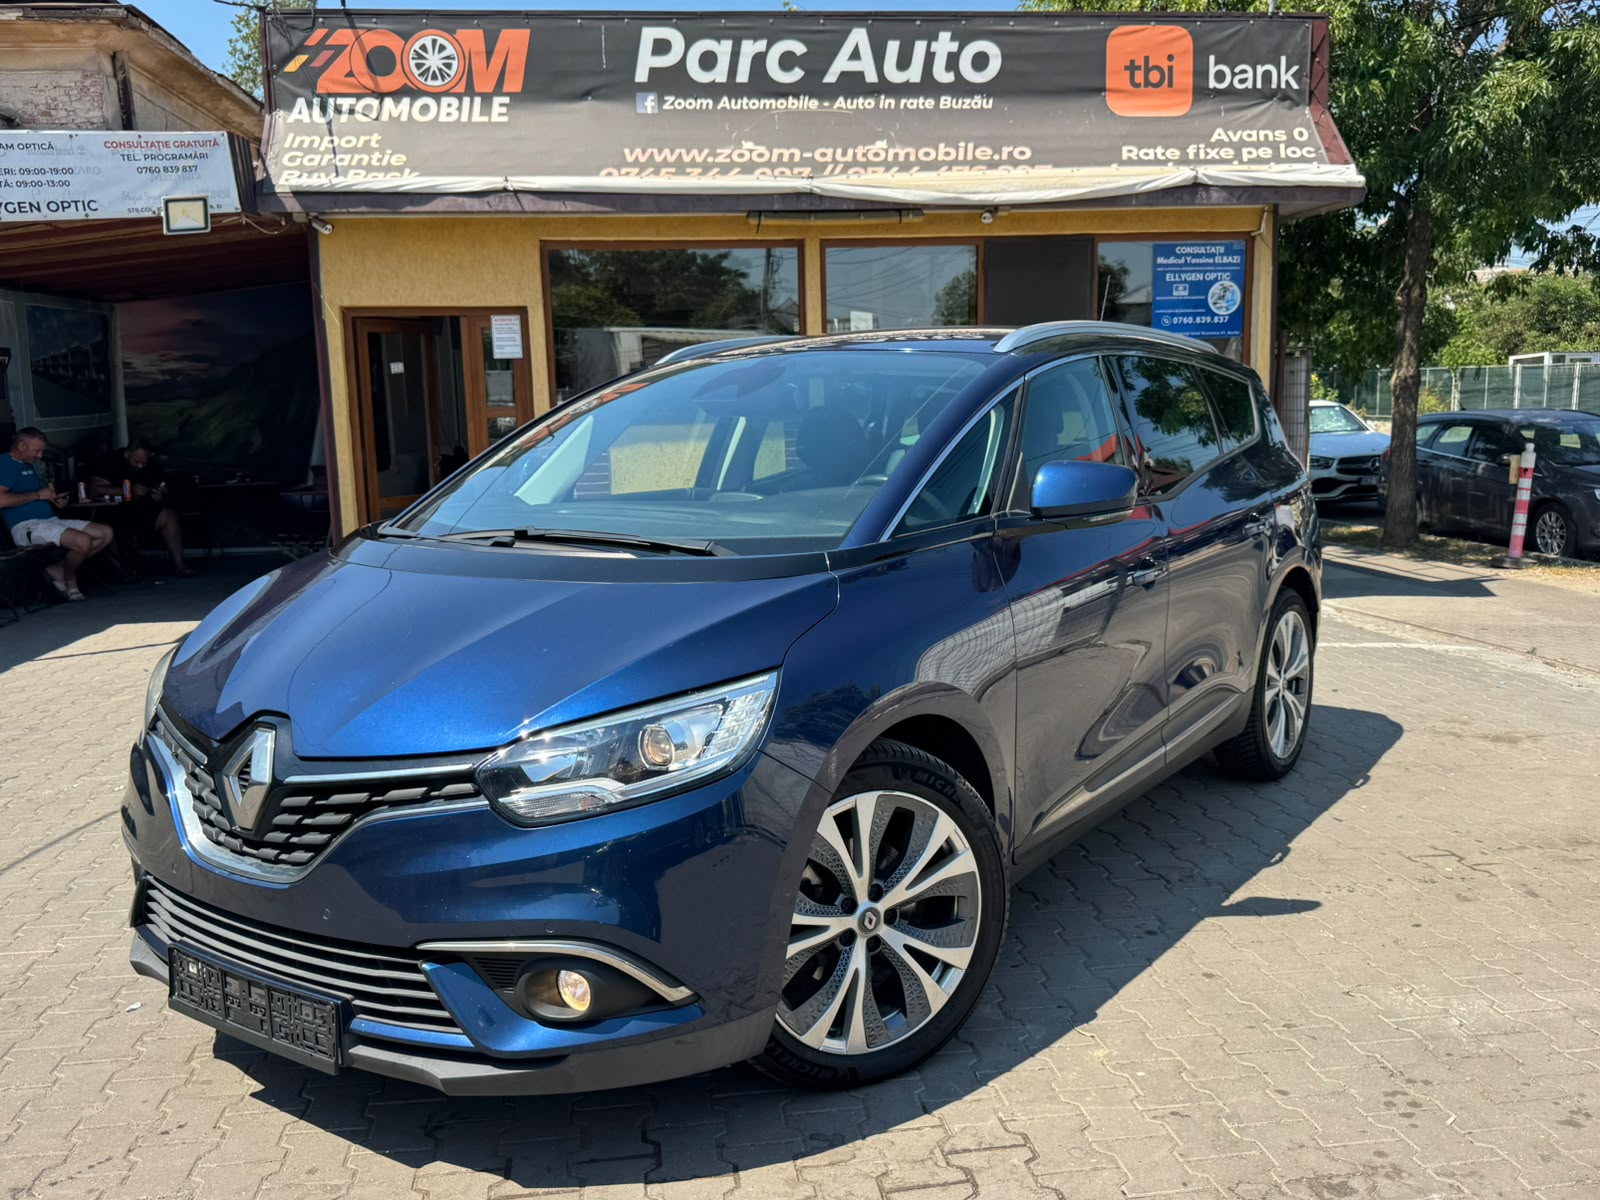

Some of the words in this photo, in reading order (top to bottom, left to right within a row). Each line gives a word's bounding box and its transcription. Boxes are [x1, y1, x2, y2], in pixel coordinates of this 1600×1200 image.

[316, 28, 531, 94] ZOOM
[634, 26, 808, 84] Parc
[822, 26, 1003, 84] Auto
[1124, 53, 1175, 88] tbi
[1208, 54, 1300, 90] bank
[287, 96, 511, 124] AUTOMOBILE
[662, 96, 713, 111] Zoom
[717, 95, 819, 110] Automobile
[833, 95, 876, 110] Auto
[899, 95, 936, 110] rate
[939, 93, 994, 111] Buzău
[283, 132, 381, 152] Import
[1209, 127, 1286, 142] Avans
[1292, 127, 1309, 142] 0
[17, 141, 54, 151] OPTICĂ
[173, 138, 220, 149] GRATUITĂ
[120, 153, 141, 162] TEL.
[143, 151, 209, 161] PROGRAMĂRI
[281, 150, 407, 167] Garantie
[623, 142, 1032, 163] www.zoom-automobile.ro
[1121, 145, 1181, 161] Rate
[1186, 144, 1234, 160] fixe
[1241, 147, 1272, 162] pe
[1279, 143, 1316, 158] loc
[18, 167, 74, 175] 09:00-19:00
[136, 167, 161, 175] 0760
[163, 166, 180, 174] 839
[182, 165, 198, 174] 837
[15, 180, 71, 188] 09:00-13:00
[46, 199, 98, 213] OPTIC
[1165, 272, 1204, 282] ELLYGEN
[1204, 272, 1231, 281] OPTIC
